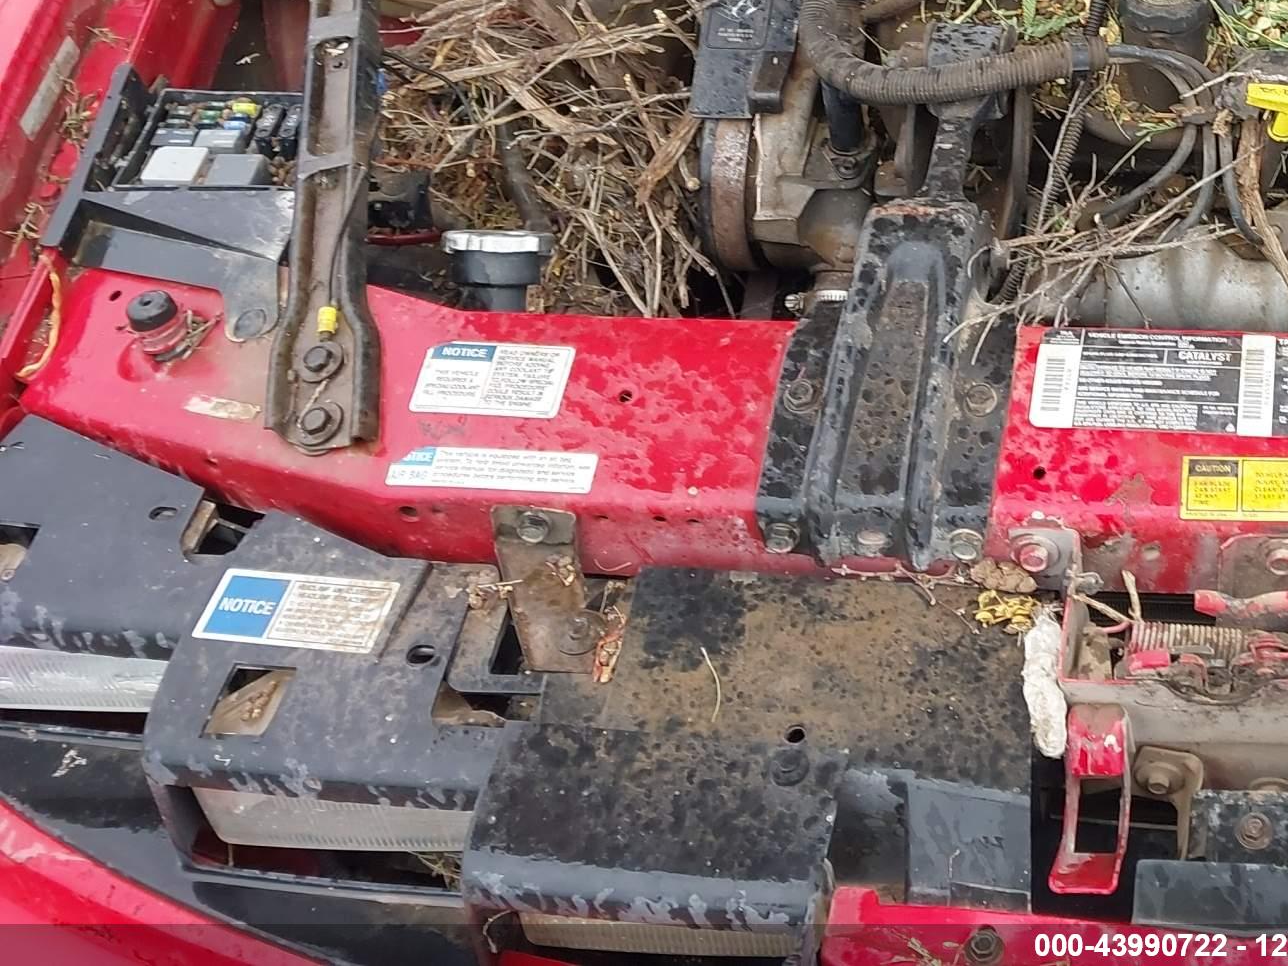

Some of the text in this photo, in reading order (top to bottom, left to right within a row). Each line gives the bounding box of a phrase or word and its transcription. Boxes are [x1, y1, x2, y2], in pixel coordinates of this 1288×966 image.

[441, 346, 489, 358] NOTICE
[1178, 351, 1232, 363] CATALYST
[1195, 464, 1232, 474] CAUTION
[218, 597, 277, 616] NOTICE
